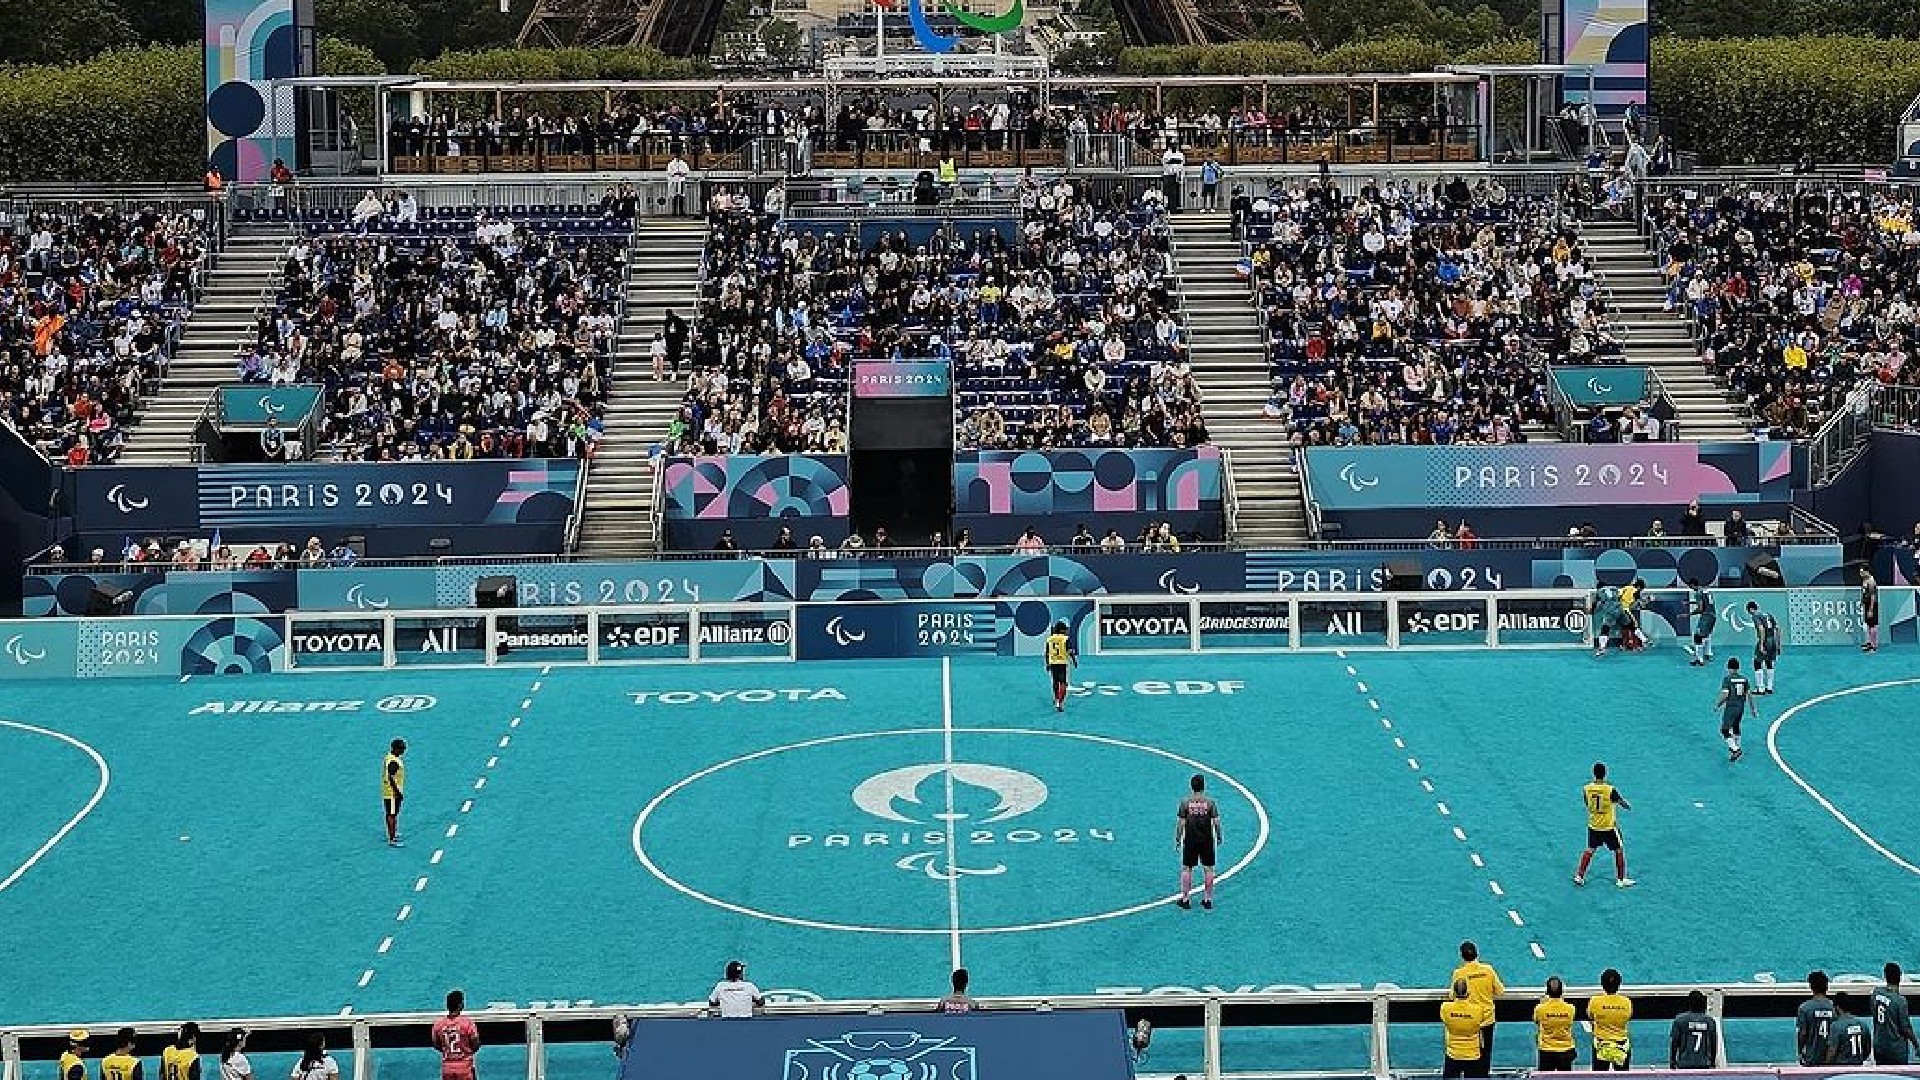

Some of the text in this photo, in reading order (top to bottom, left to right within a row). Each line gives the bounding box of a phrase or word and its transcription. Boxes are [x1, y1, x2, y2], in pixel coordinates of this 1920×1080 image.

[905, 373, 942, 384] 2024
[1576, 463, 1669, 487] 2024
[355, 483, 454, 507] 2024
[1427, 566, 1502, 590] 024
[600, 579, 700, 603] 2024
[1101, 618, 1189, 635] TOYOTA
[1498, 613, 1560, 629] Allianz
[293, 633, 383, 652] TOYOTA
[495, 631, 588, 647] Panasonic
[700, 623, 764, 643] Allianz
[918, 631, 974, 646] 2024
[102, 649, 158, 664] 2024
[626, 687, 847, 704] TOYOTA
[188, 700, 365, 714] Allianz
[788, 828, 1115, 848] PARIS 2024
[1818, 1020, 1829, 1039] 4
[443, 1032, 461, 1053] 12
[1692, 1031, 1703, 1052] 7
